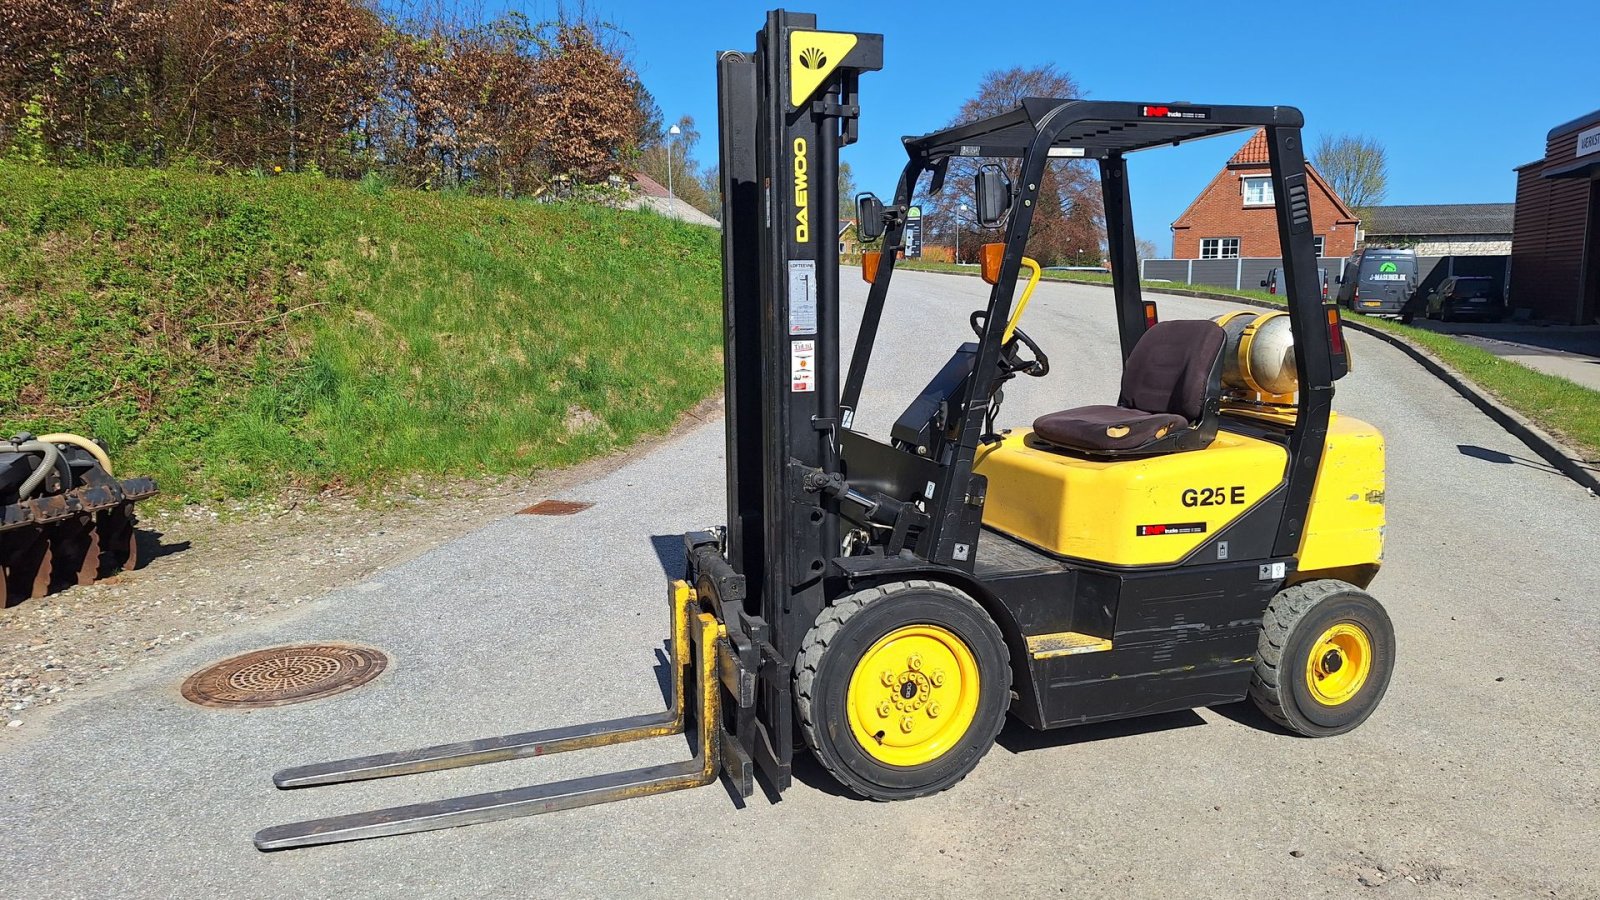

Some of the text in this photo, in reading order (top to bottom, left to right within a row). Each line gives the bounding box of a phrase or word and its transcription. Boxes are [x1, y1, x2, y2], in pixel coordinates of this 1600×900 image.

[793, 137, 809, 243] DAEWOO
[1181, 485, 1245, 507] G25 E
